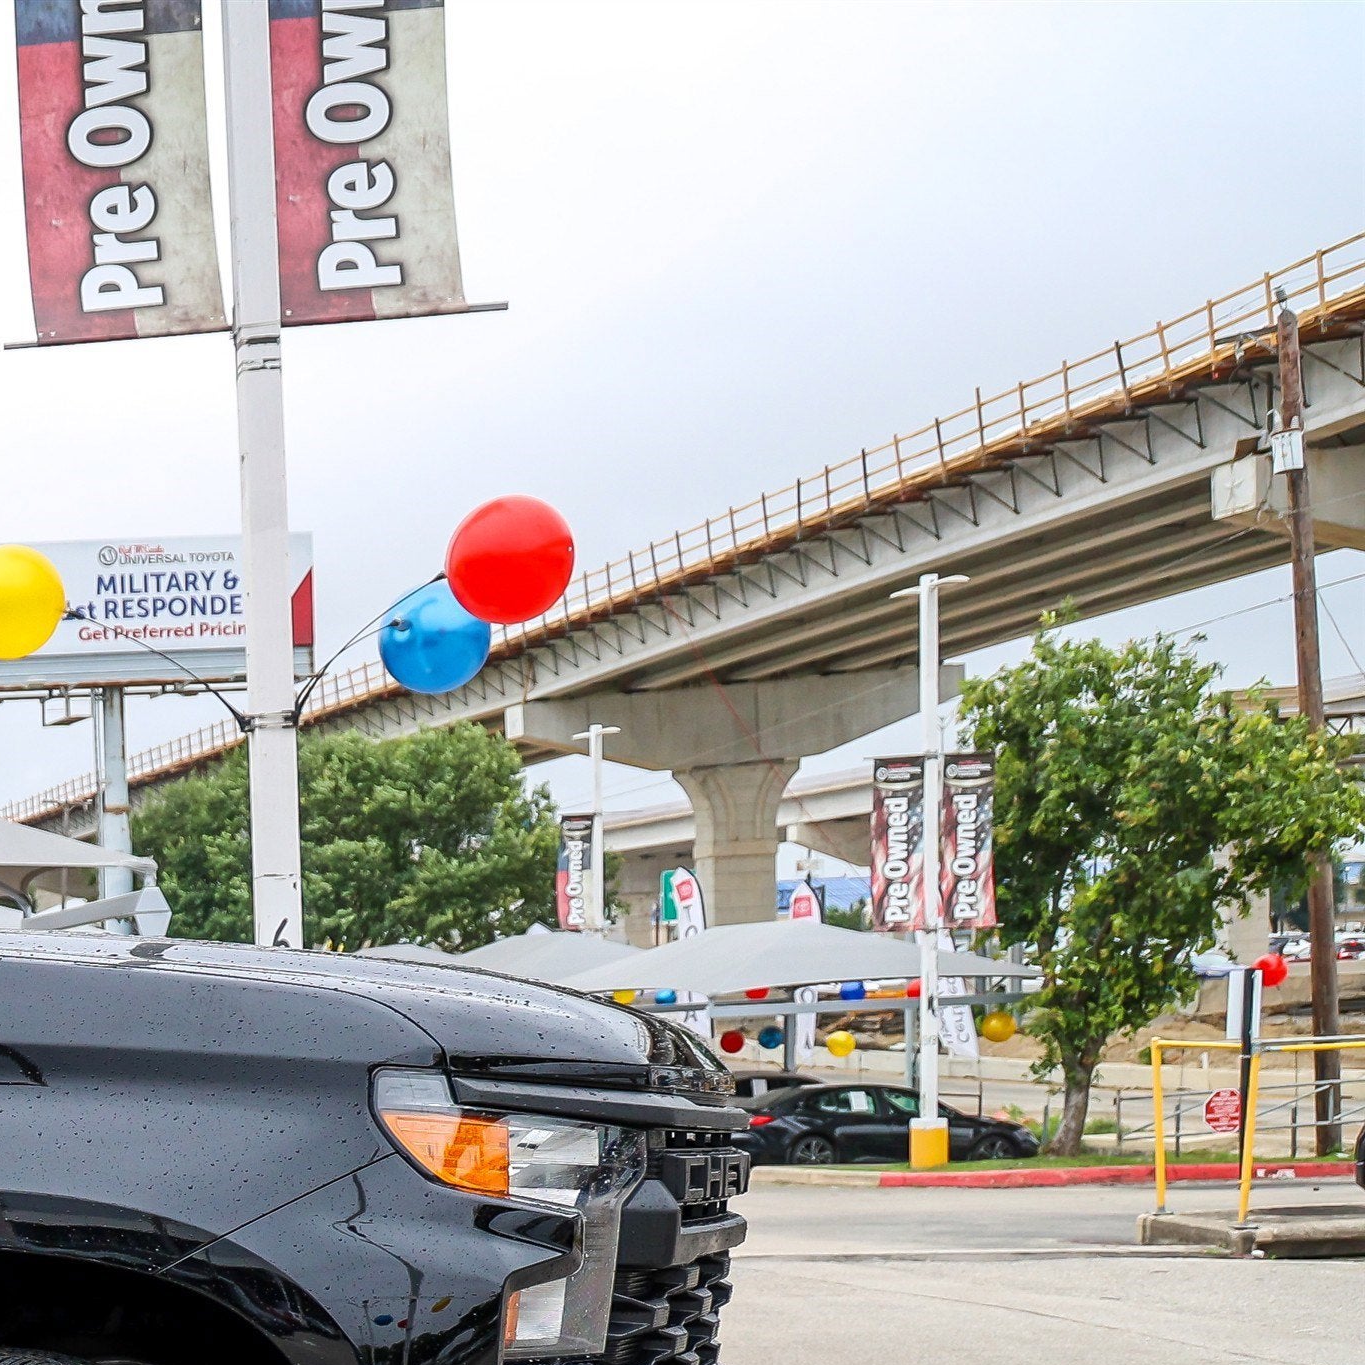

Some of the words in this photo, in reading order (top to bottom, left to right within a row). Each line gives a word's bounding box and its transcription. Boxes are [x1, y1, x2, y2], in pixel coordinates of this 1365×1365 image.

[67, 0, 152, 168] Own
[319, 161, 402, 291] Pre
[80, 184, 164, 313] Pre
[119, 553, 187, 565] UNIVERSAL
[188, 551, 235, 563] TOYOTA
[96, 569, 216, 595] MILITARY
[223, 568, 240, 590] &
[104, 593, 244, 619] RESPONDE
[78, 625, 110, 642] Get
[113, 622, 194, 640] Preferred
[199, 620, 247, 637] Pricin
[882, 796, 910, 880] Owned
[951, 793, 978, 877] Owned
[564, 840, 584, 897] Owned
[566, 897, 585, 926] Pre
[884, 881, 910, 923] Pre
[953, 878, 979, 920] Pre
